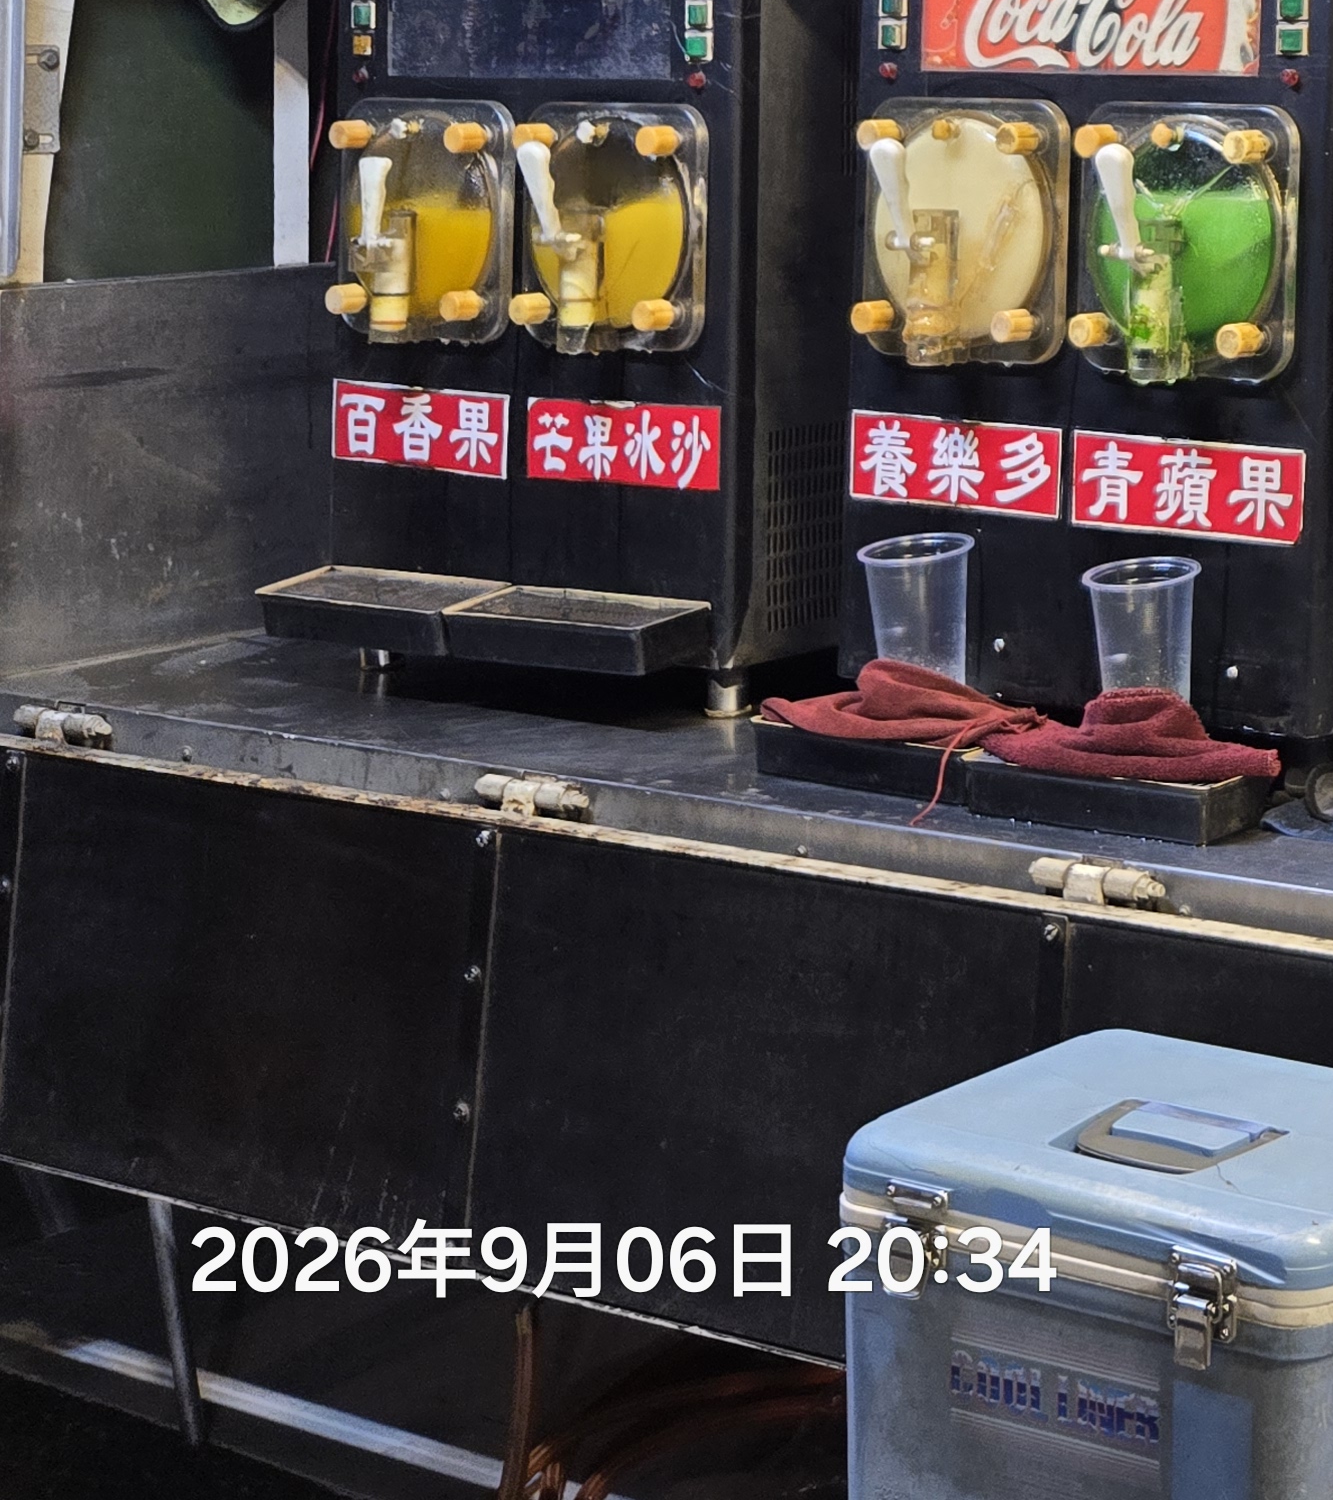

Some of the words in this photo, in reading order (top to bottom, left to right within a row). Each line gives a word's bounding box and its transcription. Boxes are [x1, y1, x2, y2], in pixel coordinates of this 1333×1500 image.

[341, 392, 498, 469] 百香果
[533, 410, 711, 490] 芒果冰沙
[859, 420, 1051, 504] 養樂多
[1081, 441, 1294, 531] 青蘋果
[950, 1350, 1048, 1422] COOL
